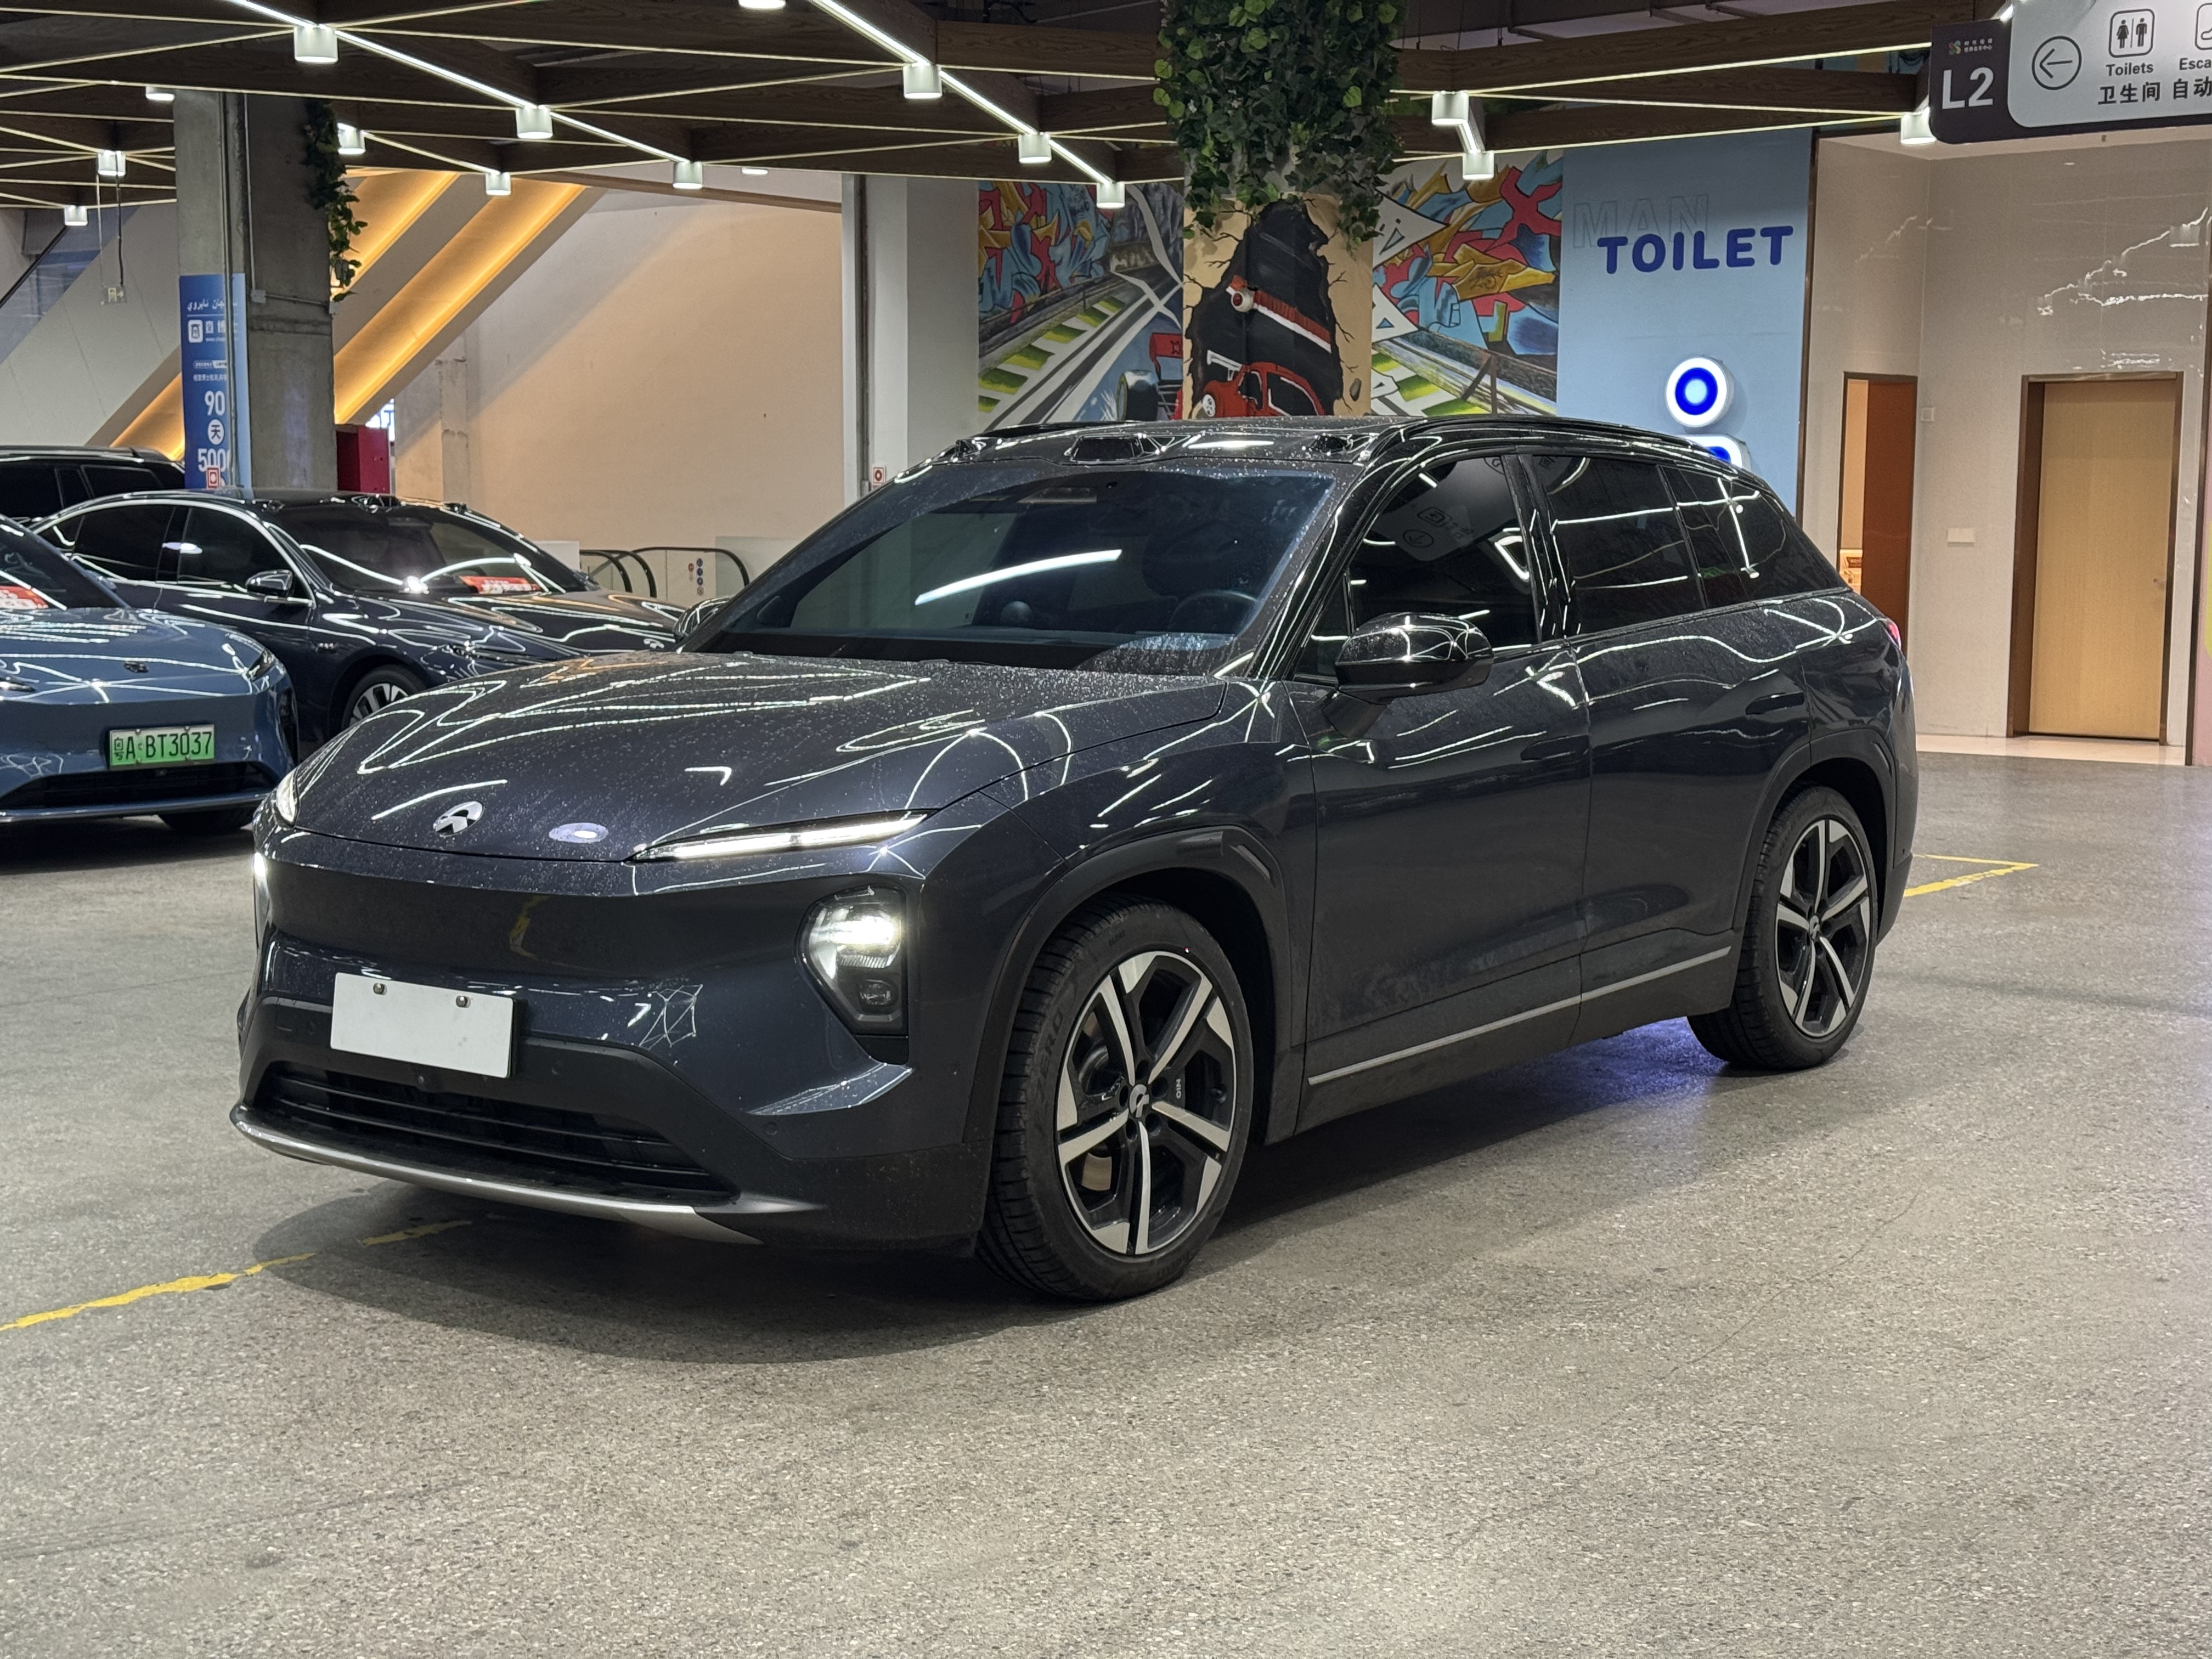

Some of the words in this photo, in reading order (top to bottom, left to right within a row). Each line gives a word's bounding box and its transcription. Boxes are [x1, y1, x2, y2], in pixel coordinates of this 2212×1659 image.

[2106, 61, 2154, 77] Toilets
[2179, 58, 2212, 71] Esca
[1942, 66, 1994, 110] L2
[2097, 81, 2161, 105] 卫生间
[2172, 76, 2212, 100] 自动
[1572, 194, 1710, 249] MAN
[1597, 225, 1794, 274] TOILET
[204, 390, 225, 416] 90
[211, 424, 221, 440] 天
